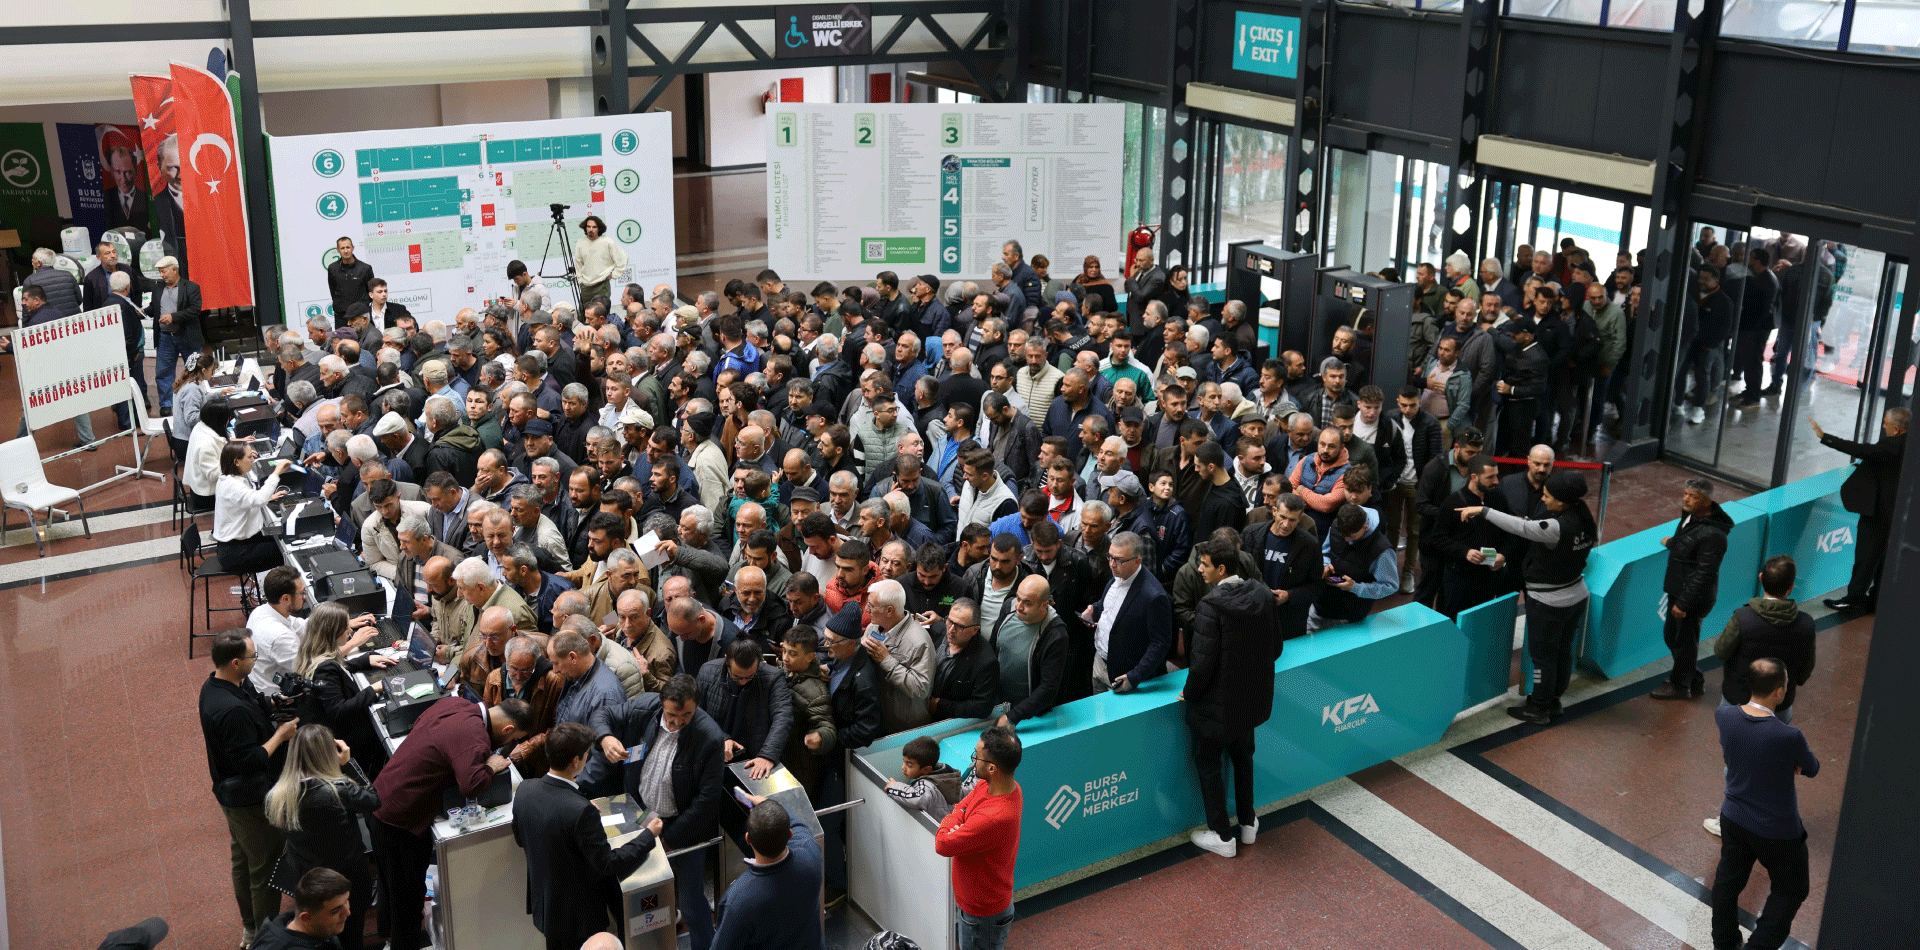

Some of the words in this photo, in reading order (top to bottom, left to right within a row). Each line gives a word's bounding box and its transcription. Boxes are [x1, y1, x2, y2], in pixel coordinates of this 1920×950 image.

[812, 20, 840, 29] ENGELLİ
[841, 20, 863, 28] ERKEK
[812, 30, 843, 47] WC
[1250, 26, 1284, 46] ÇIKIŞ
[1252, 46, 1280, 63] EXIT
[621, 137, 630, 148] 5
[782, 126, 790, 143] 1
[858, 127, 872, 144] 2
[945, 127, 958, 144] 3
[323, 157, 334, 169] 6
[623, 176, 631, 186] 3
[943, 187, 959, 205] 4
[327, 200, 338, 212] 4
[626, 227, 632, 237] 1
[944, 219, 958, 236] 5
[943, 246, 958, 264] 6
[1816, 526, 1854, 553] KFA
[1322, 693, 1380, 726] KFA
[1085, 770, 1127, 793] BURSA
[1083, 788, 1139, 817] MERKEZİ
[1084, 786, 1118, 805] FUAR
